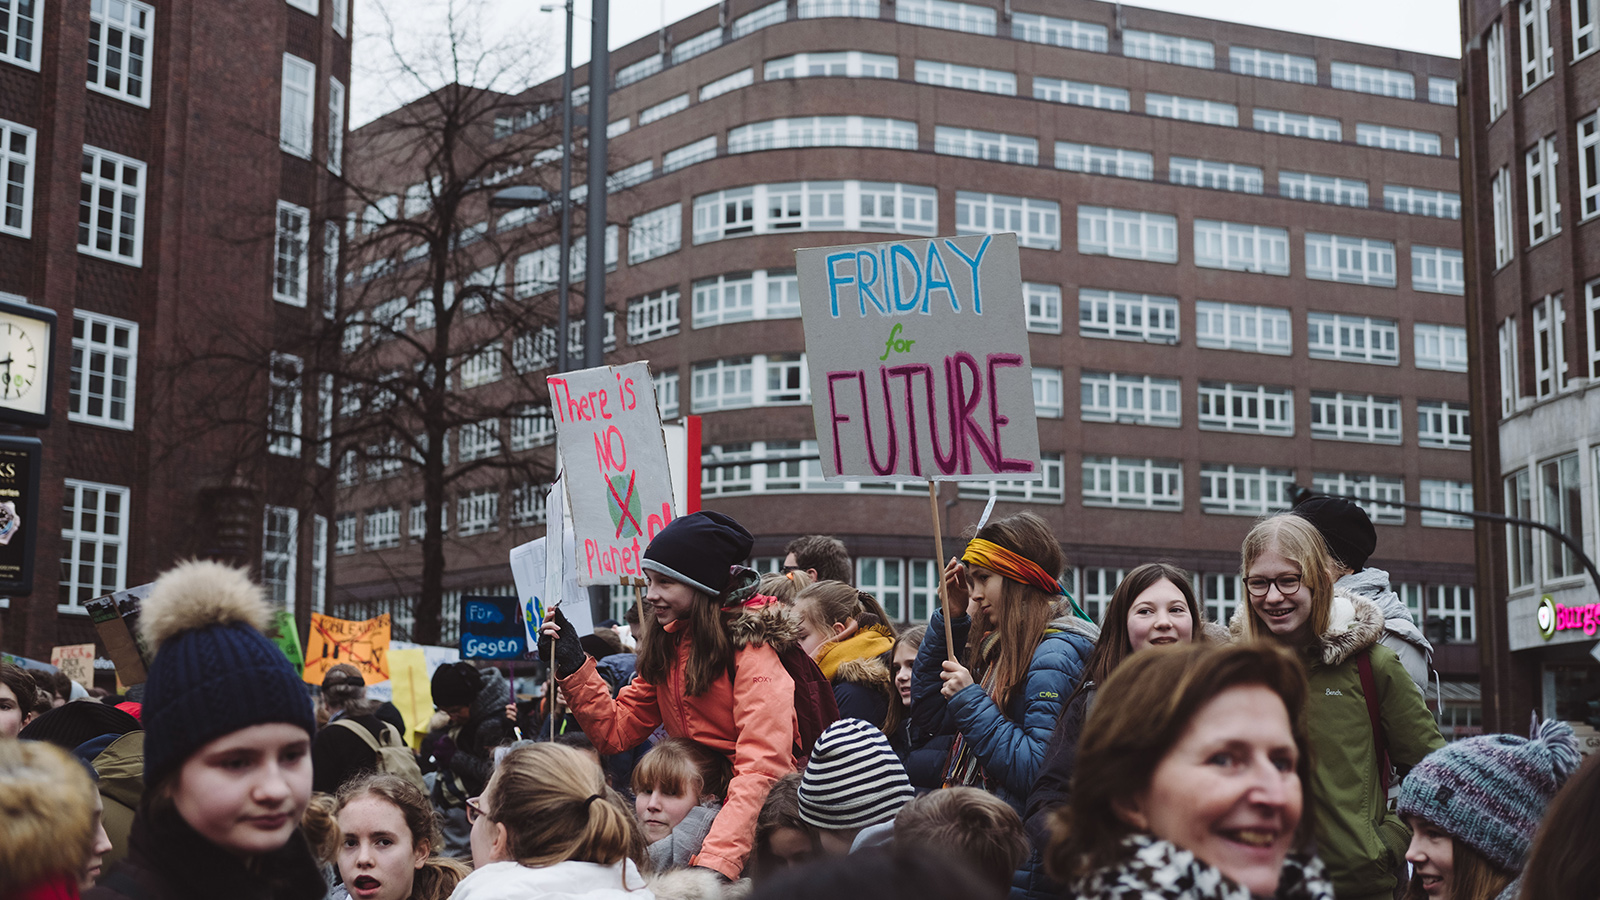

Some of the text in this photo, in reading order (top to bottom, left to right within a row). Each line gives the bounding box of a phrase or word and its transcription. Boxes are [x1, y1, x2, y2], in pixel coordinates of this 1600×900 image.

[825, 233, 993, 318] FRIDAY
[879, 323, 916, 361] for
[547, 372, 636, 423] There is
[826, 351, 1035, 477] FUTURE
[593, 425, 627, 474] NO
[584, 537, 642, 579] Planet
[470, 605, 493, 620] Für
[465, 639, 518, 658] Gegen
